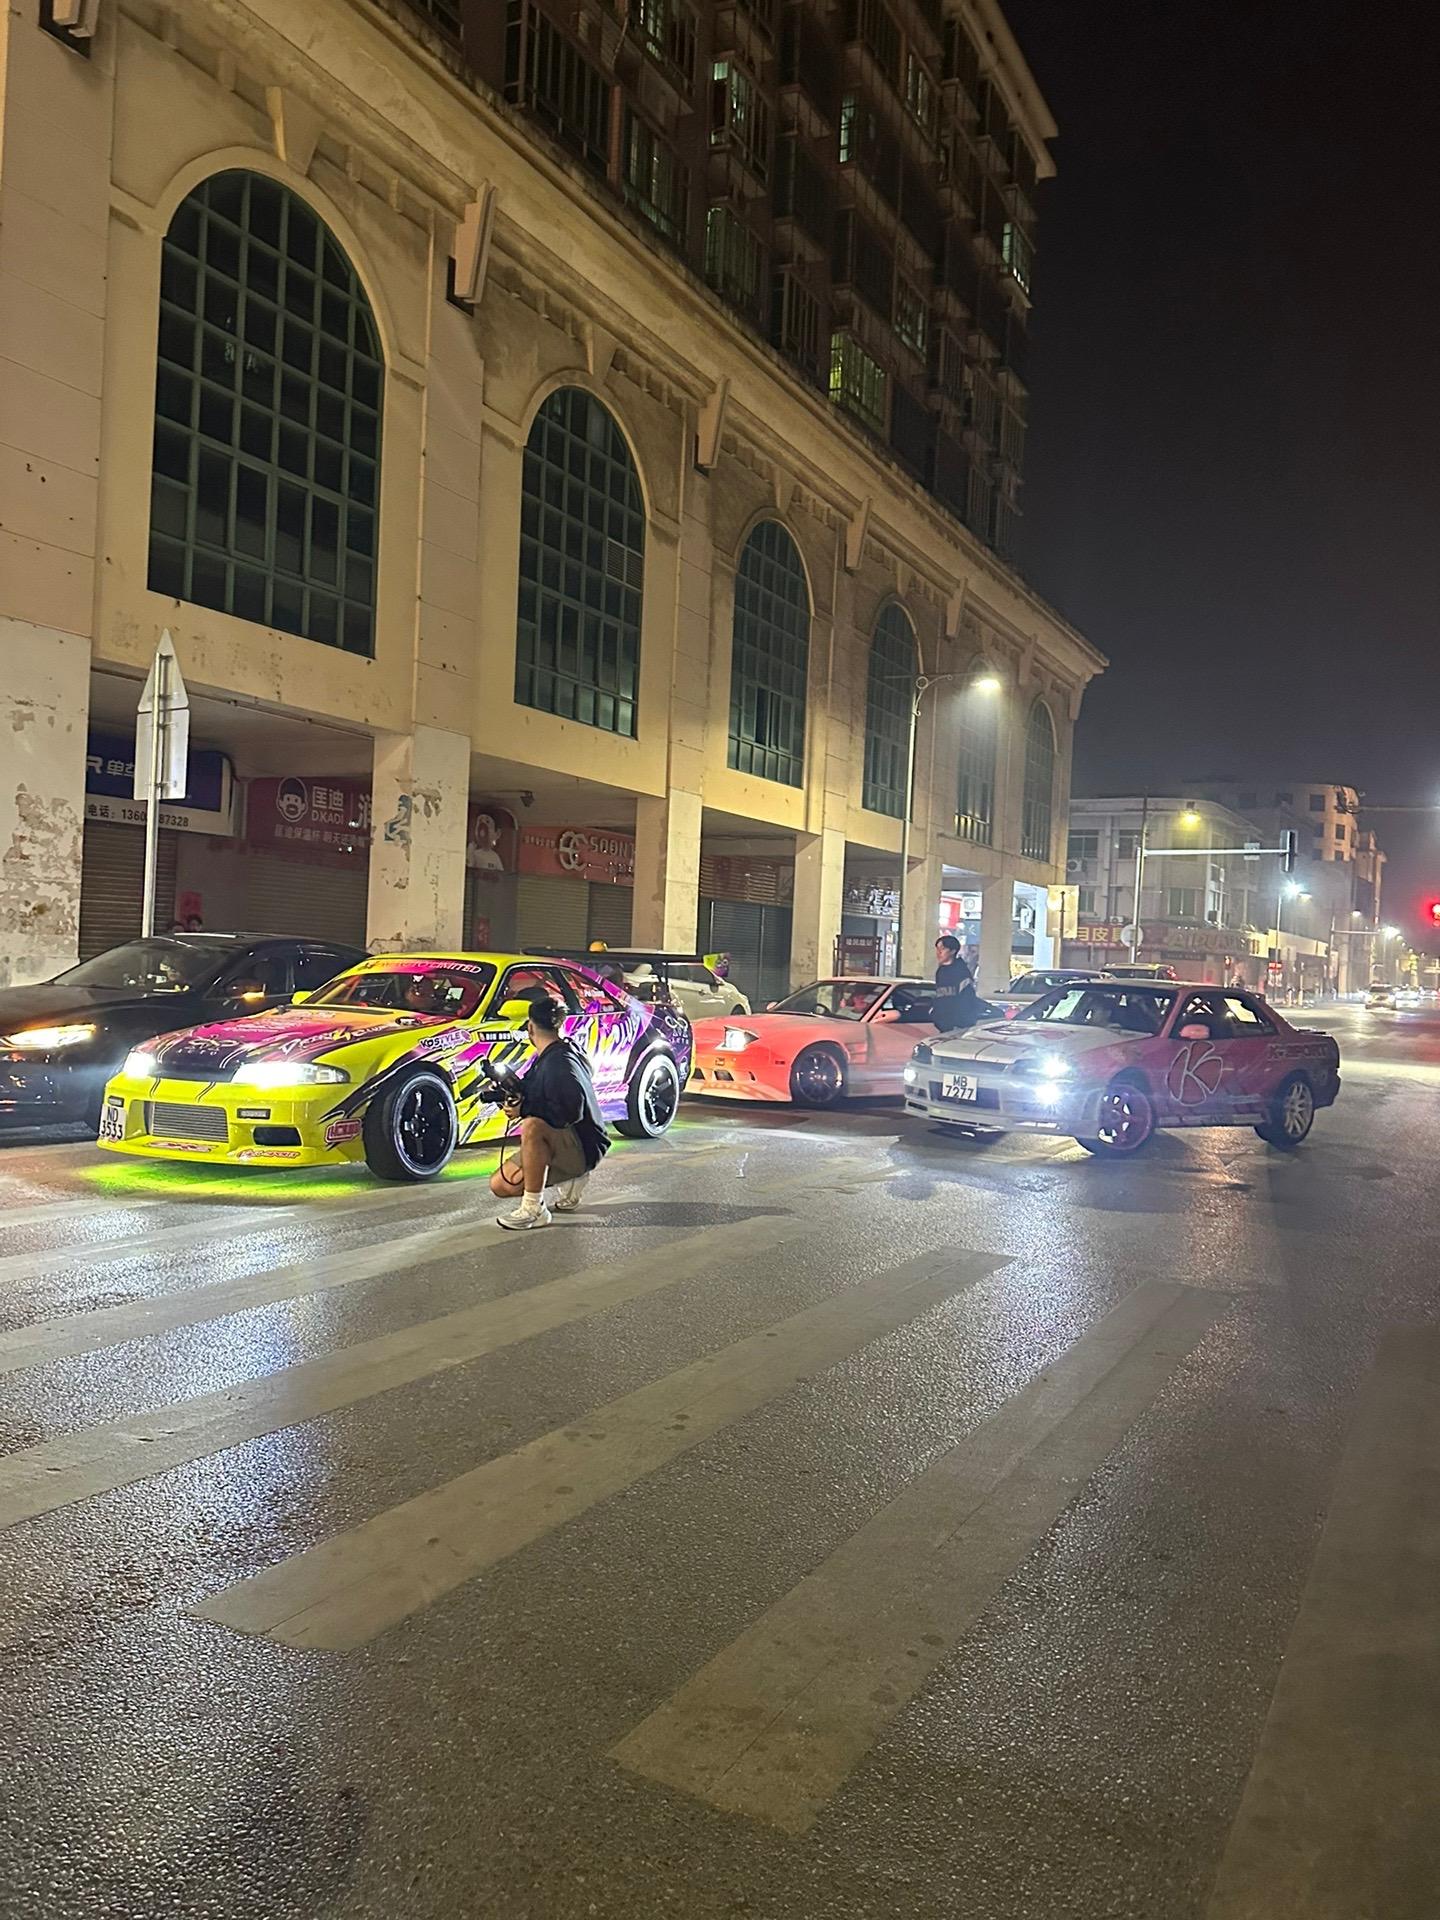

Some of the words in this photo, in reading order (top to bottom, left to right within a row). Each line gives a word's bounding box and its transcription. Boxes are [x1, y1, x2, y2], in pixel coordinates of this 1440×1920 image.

[312, 786, 344, 812] 匡迪
[121, 808, 189, 828] 136087328
[953, 1075, 968, 1087] MB
[945, 1085, 975, 1099] 7277
[107, 1106, 119, 1123] ND
[100, 1120, 123, 1140] 3533
